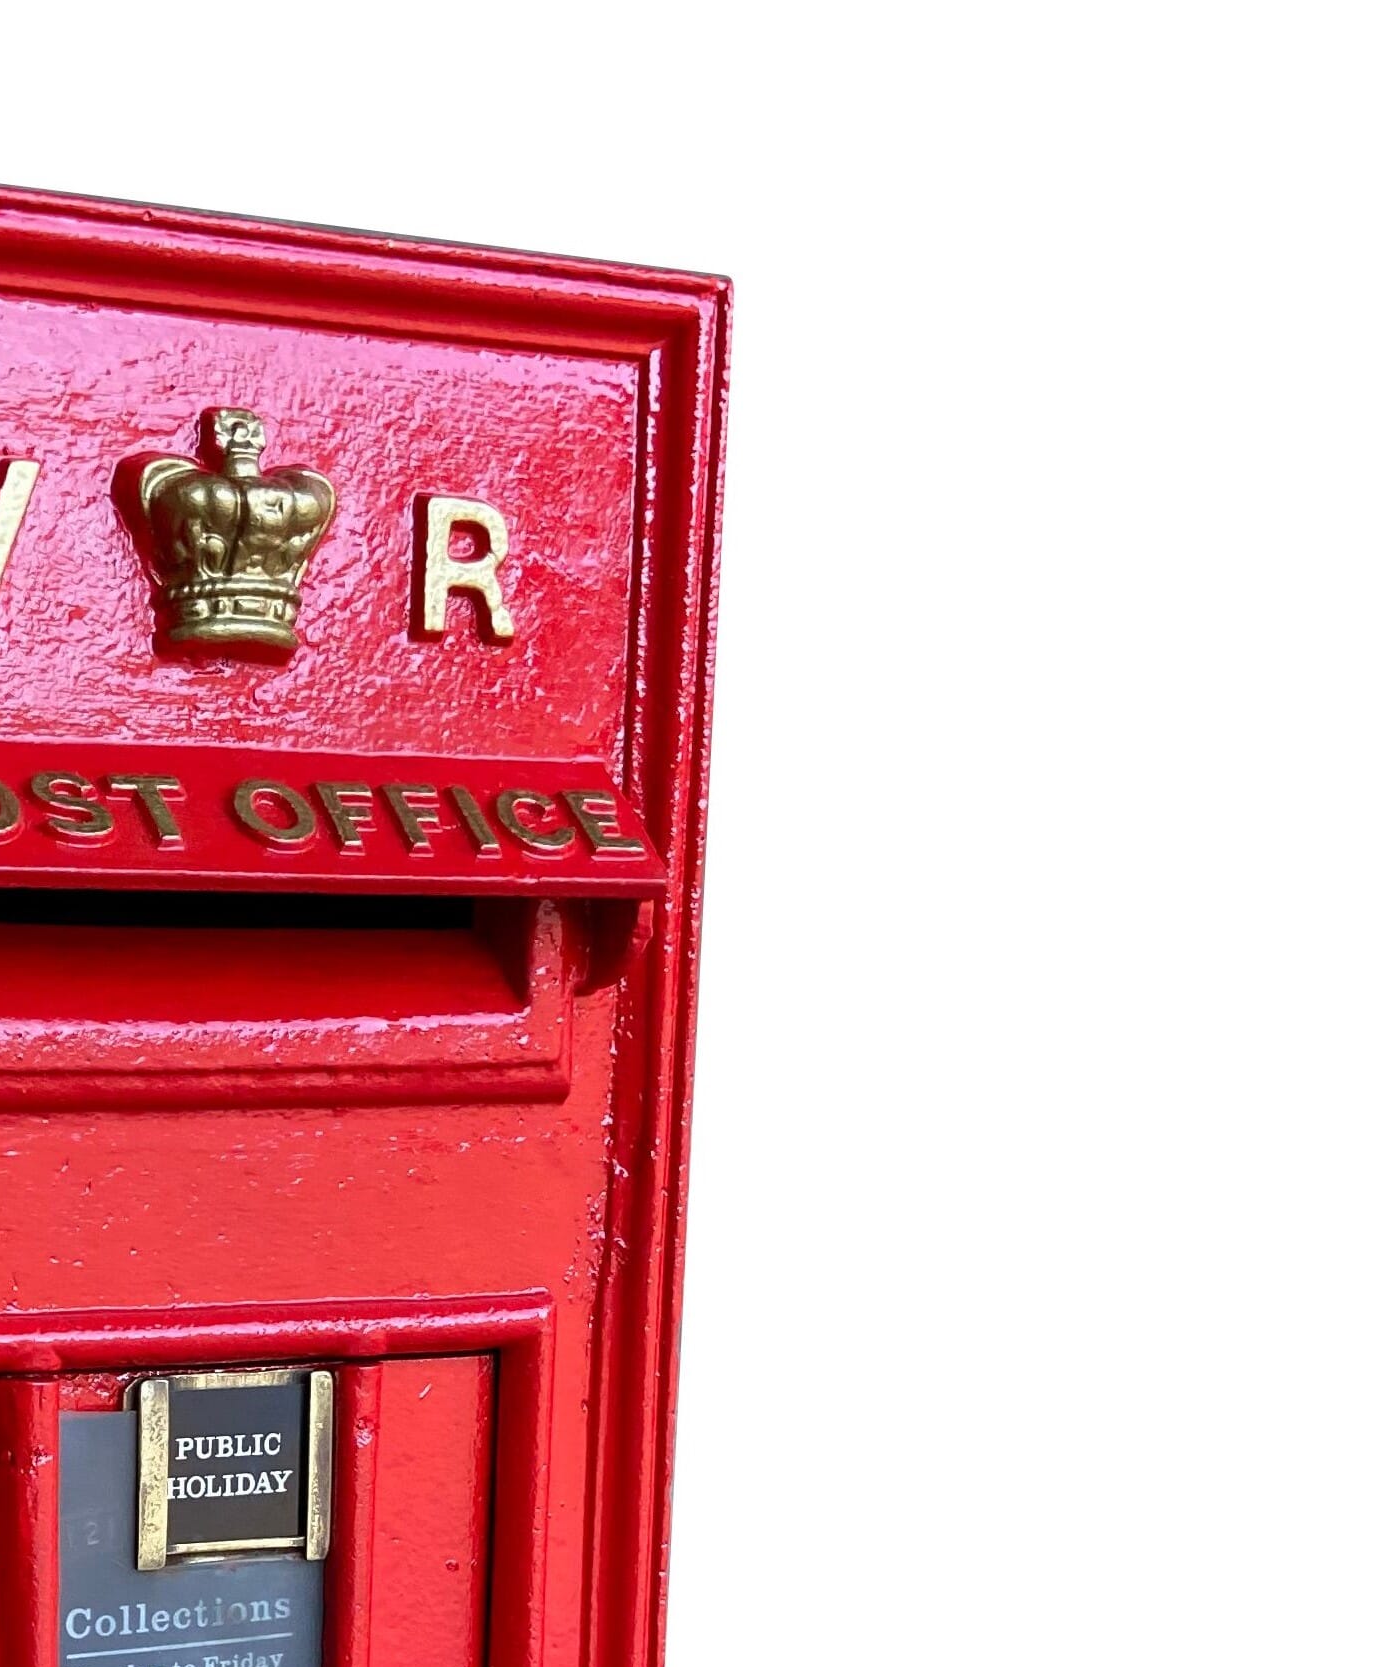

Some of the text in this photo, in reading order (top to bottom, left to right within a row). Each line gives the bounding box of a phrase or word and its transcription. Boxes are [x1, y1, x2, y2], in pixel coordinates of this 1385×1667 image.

[421, 494, 516, 640] R
[233, 778, 646, 862] OFFICE
[174, 1432, 282, 1461] PUBLIC
[167, 1470, 293, 1500] HOLIDAY
[65, 1596, 291, 1640] Collections
